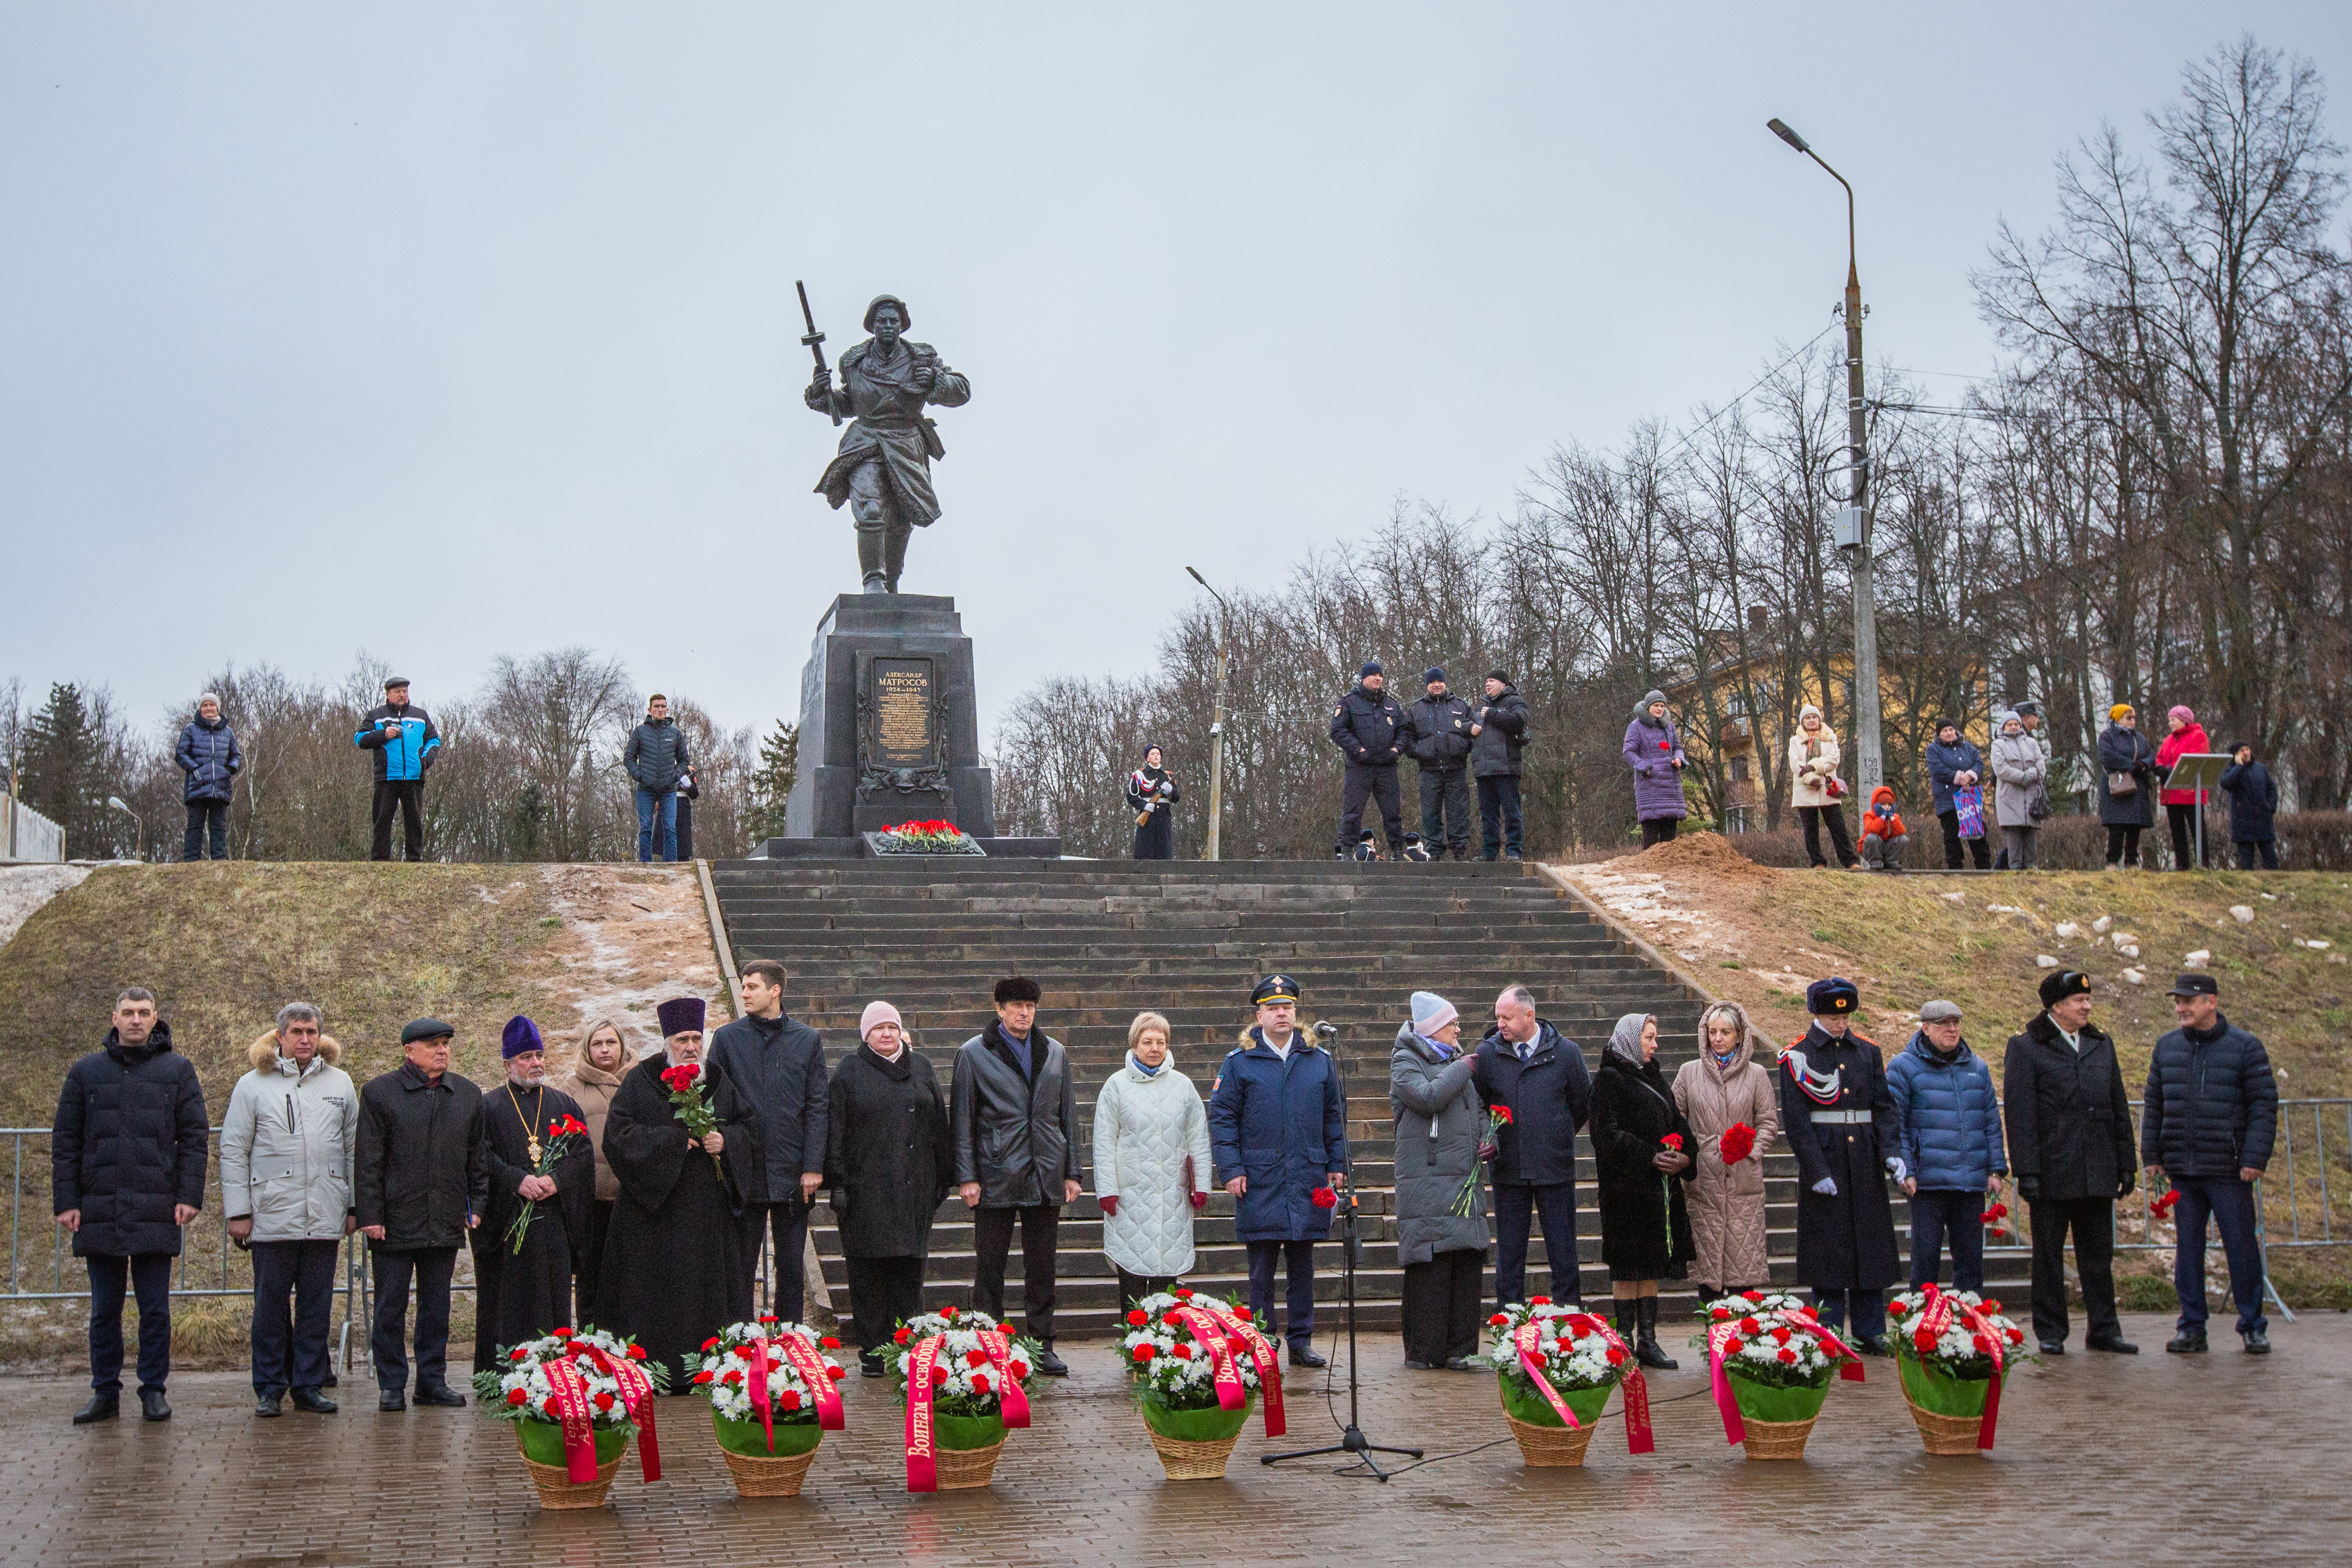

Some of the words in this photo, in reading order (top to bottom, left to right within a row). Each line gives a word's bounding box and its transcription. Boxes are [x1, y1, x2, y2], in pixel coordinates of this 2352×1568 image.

[879, 678, 927, 686] МАТРОСОВ
[1864, 757, 1877, 769] 159
[560, 1359, 591, 1446] Александру
[802, 1366, 826, 1403] Луки
[1264, 1368, 1279, 1405] области
[565, 1399, 579, 1448] Герою
[907, 1401, 930, 1458] Воинам
